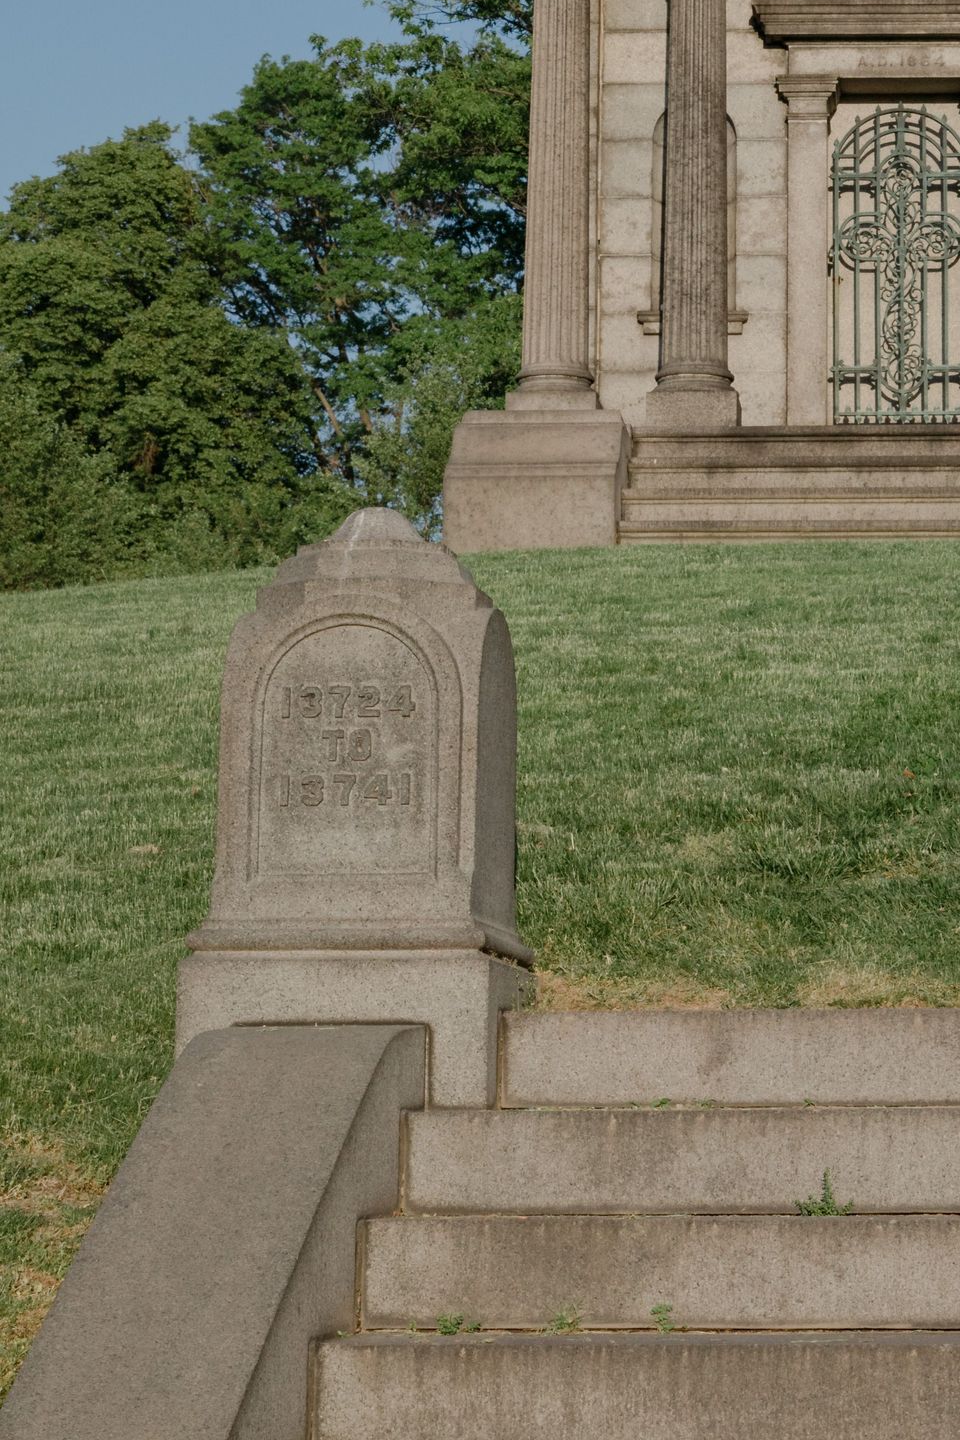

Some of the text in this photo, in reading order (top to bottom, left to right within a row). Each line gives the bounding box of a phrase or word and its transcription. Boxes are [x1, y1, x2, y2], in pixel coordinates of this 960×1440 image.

[280, 684, 416, 719] 13724
[321, 729, 372, 762] TO
[279, 772, 411, 808] 13741
